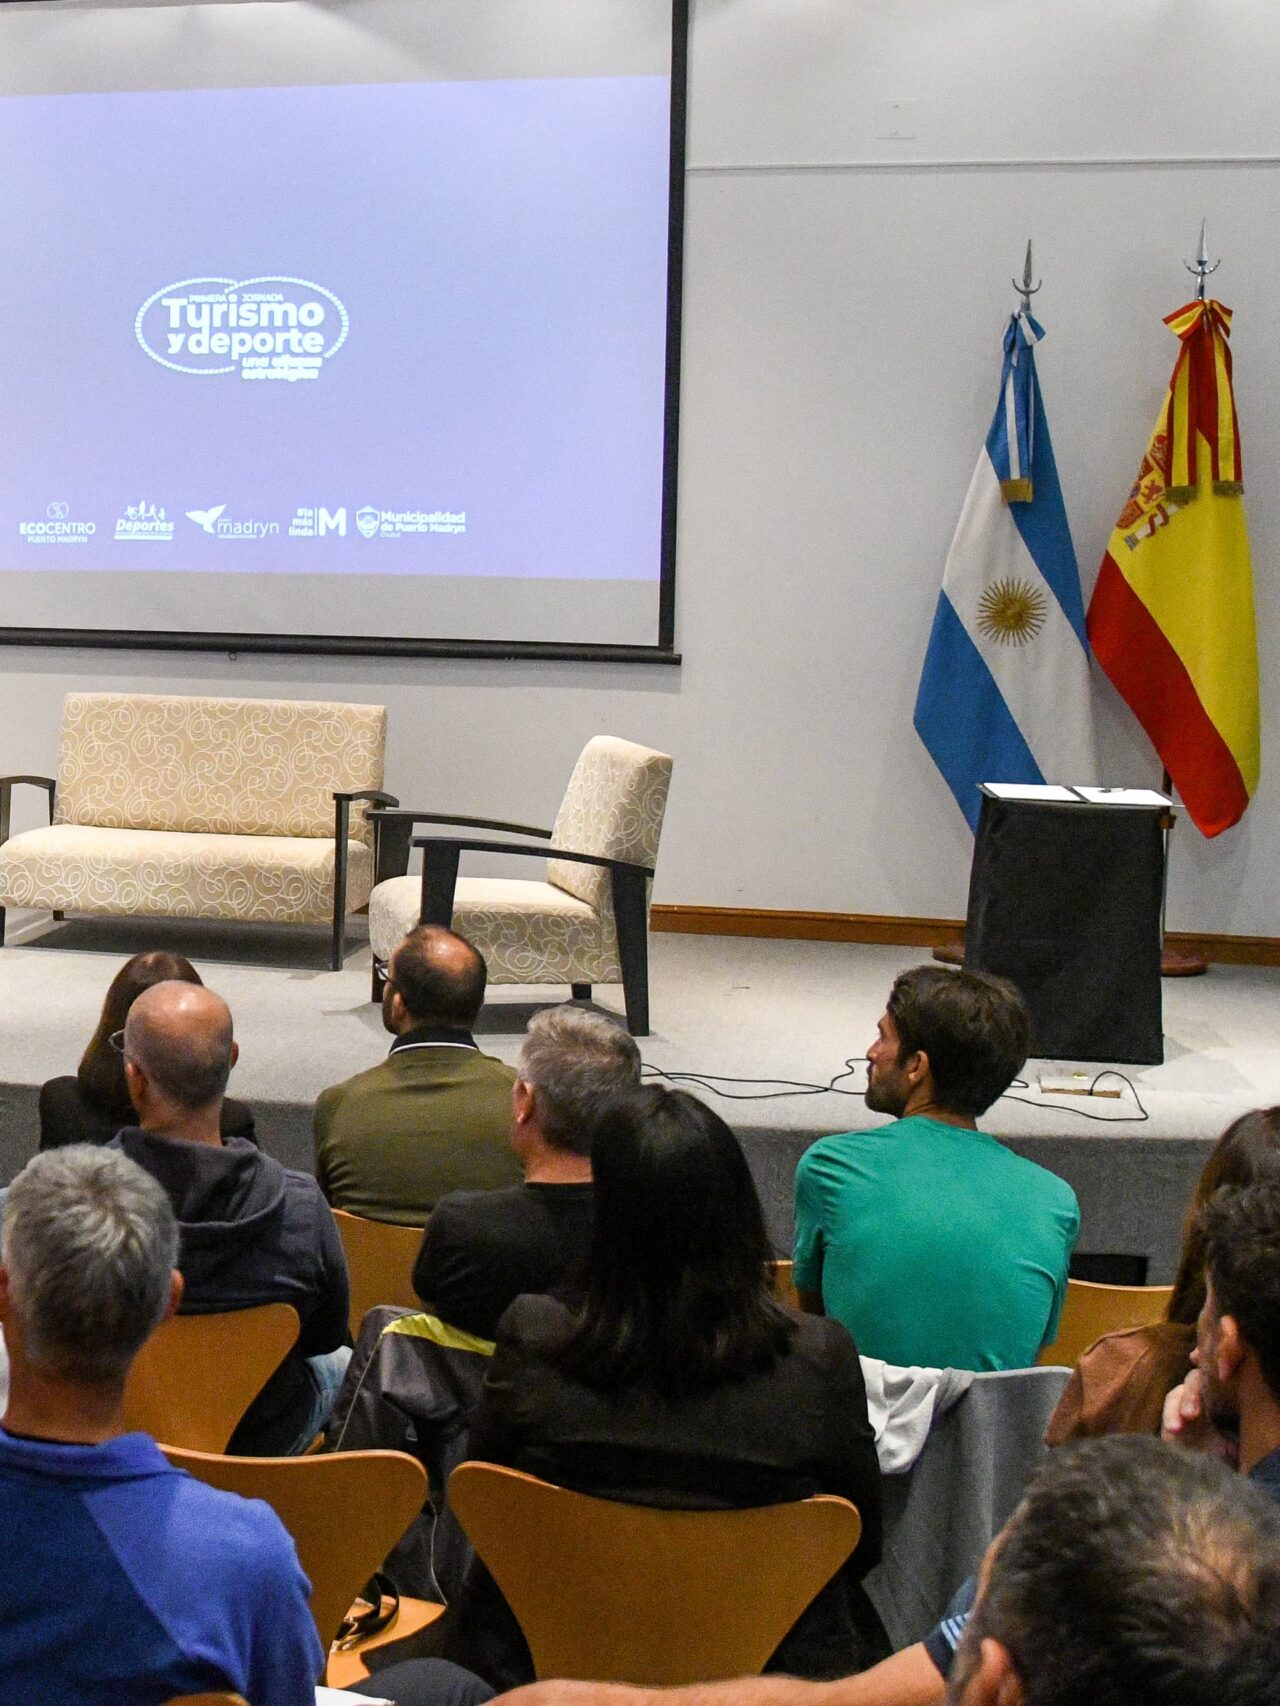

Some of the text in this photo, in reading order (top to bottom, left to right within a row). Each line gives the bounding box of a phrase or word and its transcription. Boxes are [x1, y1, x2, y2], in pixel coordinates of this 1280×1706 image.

[242, 292, 284, 302] JORNADA
[161, 293, 325, 328] Turismo
[318, 508, 347, 537] M
[380, 511, 466, 524] Municipalidad
[19, 521, 96, 535] ECOCENTRO
[115, 518, 175, 535] Deportes
[217, 519, 279, 538] madryn
[288, 526, 314, 536] linda
[380, 523, 466, 535] de Puerto Madryn
